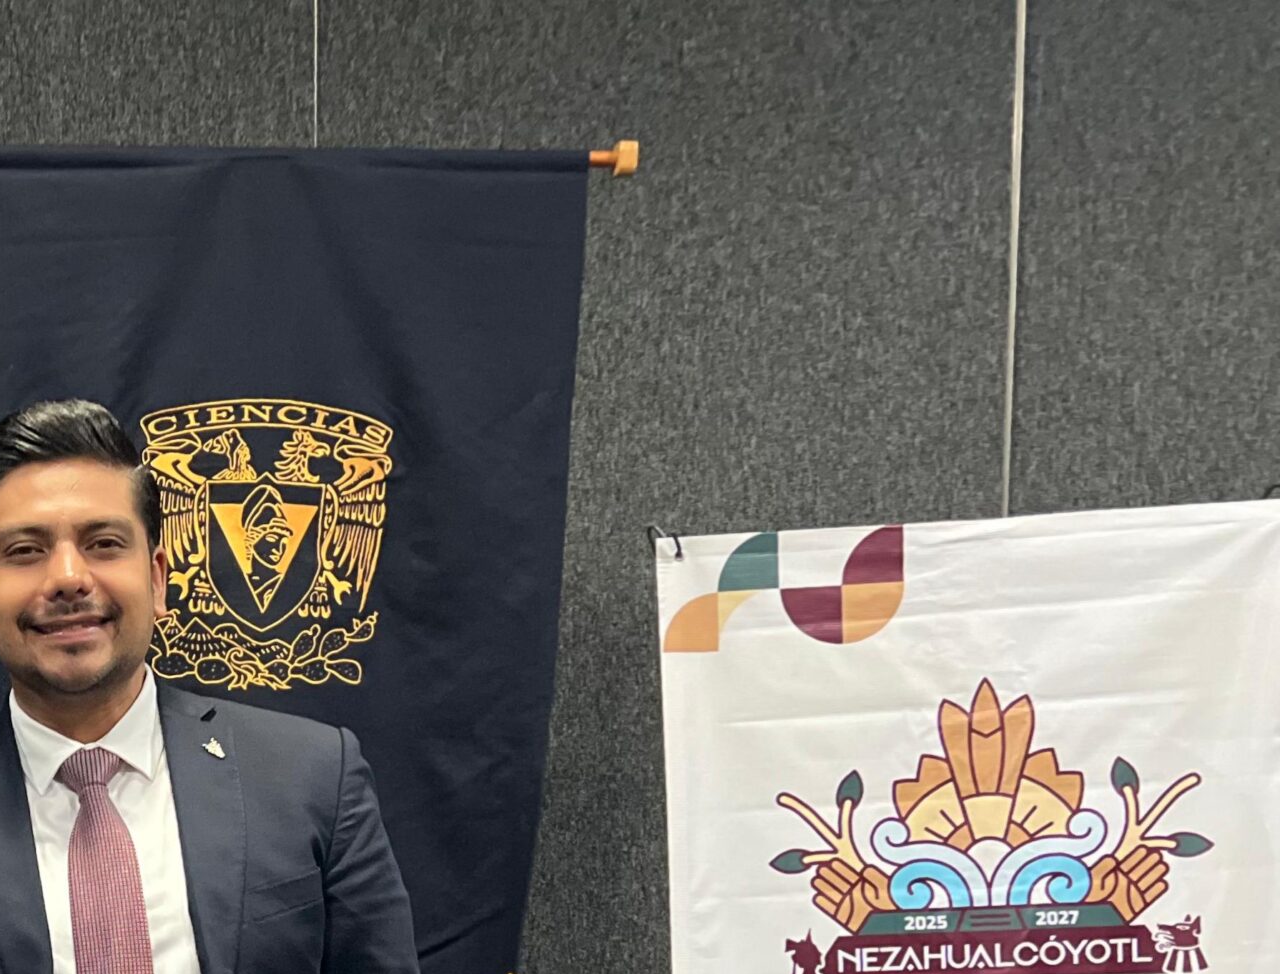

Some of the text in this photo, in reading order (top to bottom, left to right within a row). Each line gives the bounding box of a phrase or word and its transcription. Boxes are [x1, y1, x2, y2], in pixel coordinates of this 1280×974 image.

[148, 404, 386, 444] CIENCIAS
[904, 910, 1079, 930] 2025 2027
[837, 936, 1152, 974] NEZAHUALCÓYOTL
